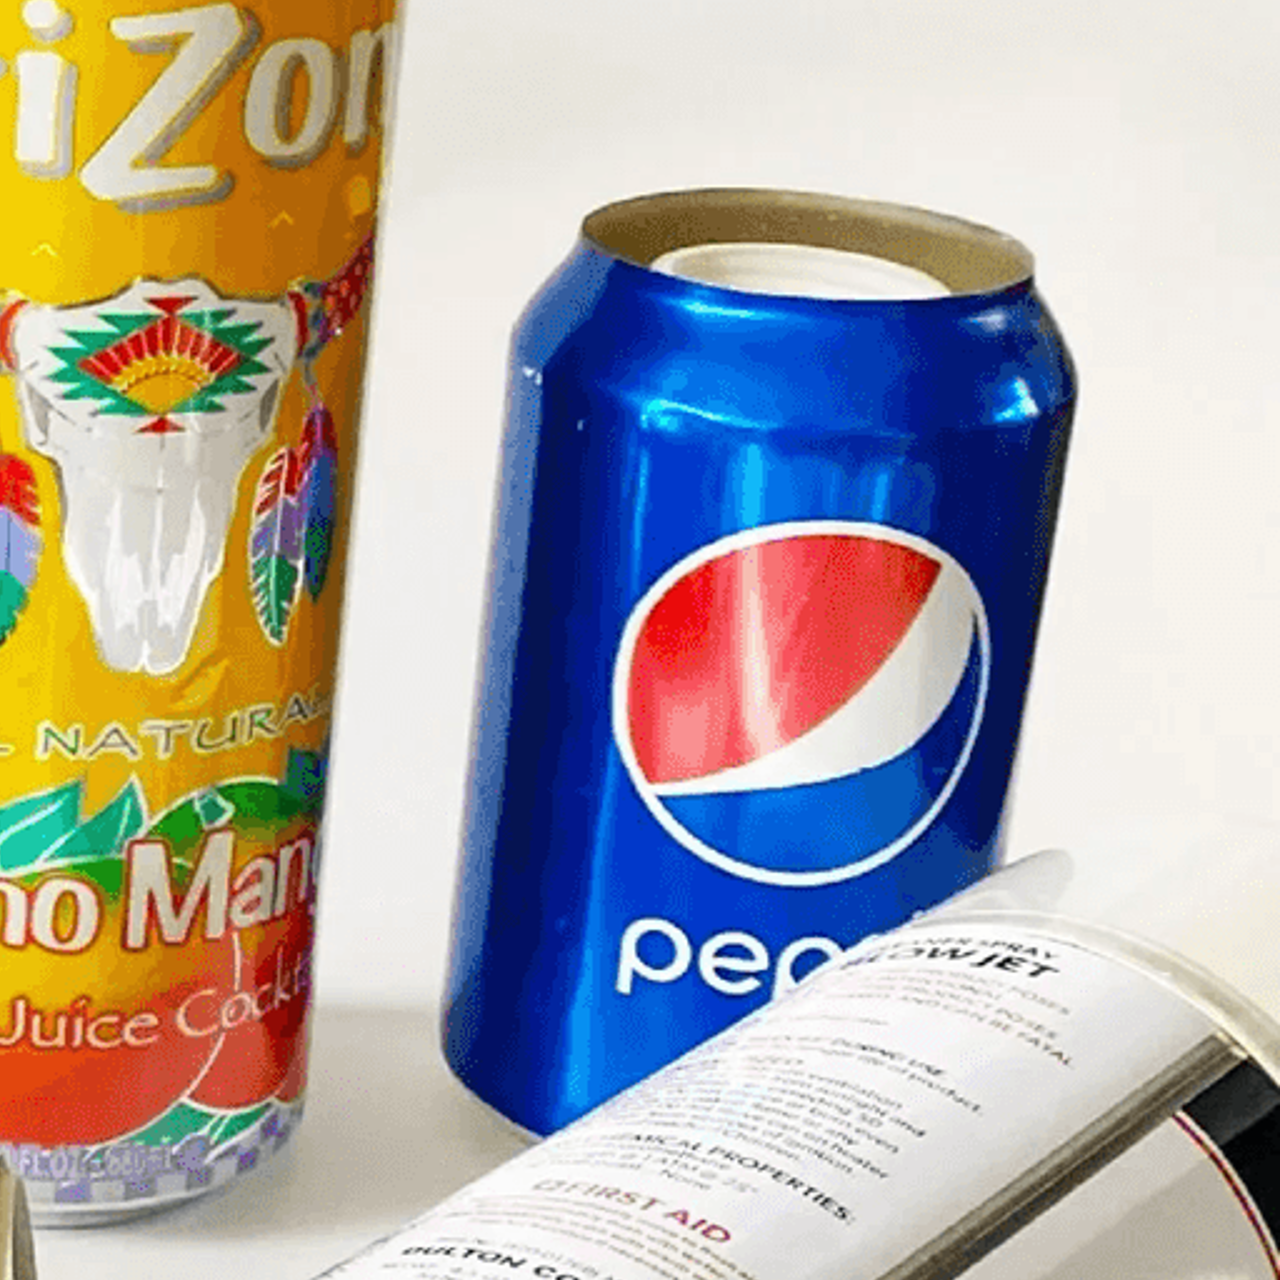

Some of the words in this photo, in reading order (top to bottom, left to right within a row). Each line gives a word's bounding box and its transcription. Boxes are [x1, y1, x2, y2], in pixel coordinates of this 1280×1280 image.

[970, 953, 1061, 977] JET
[566, 1177, 667, 1212] FIRST
[666, 1206, 733, 1245] AID
[705, 1140, 854, 1224] PROPERTIES:
